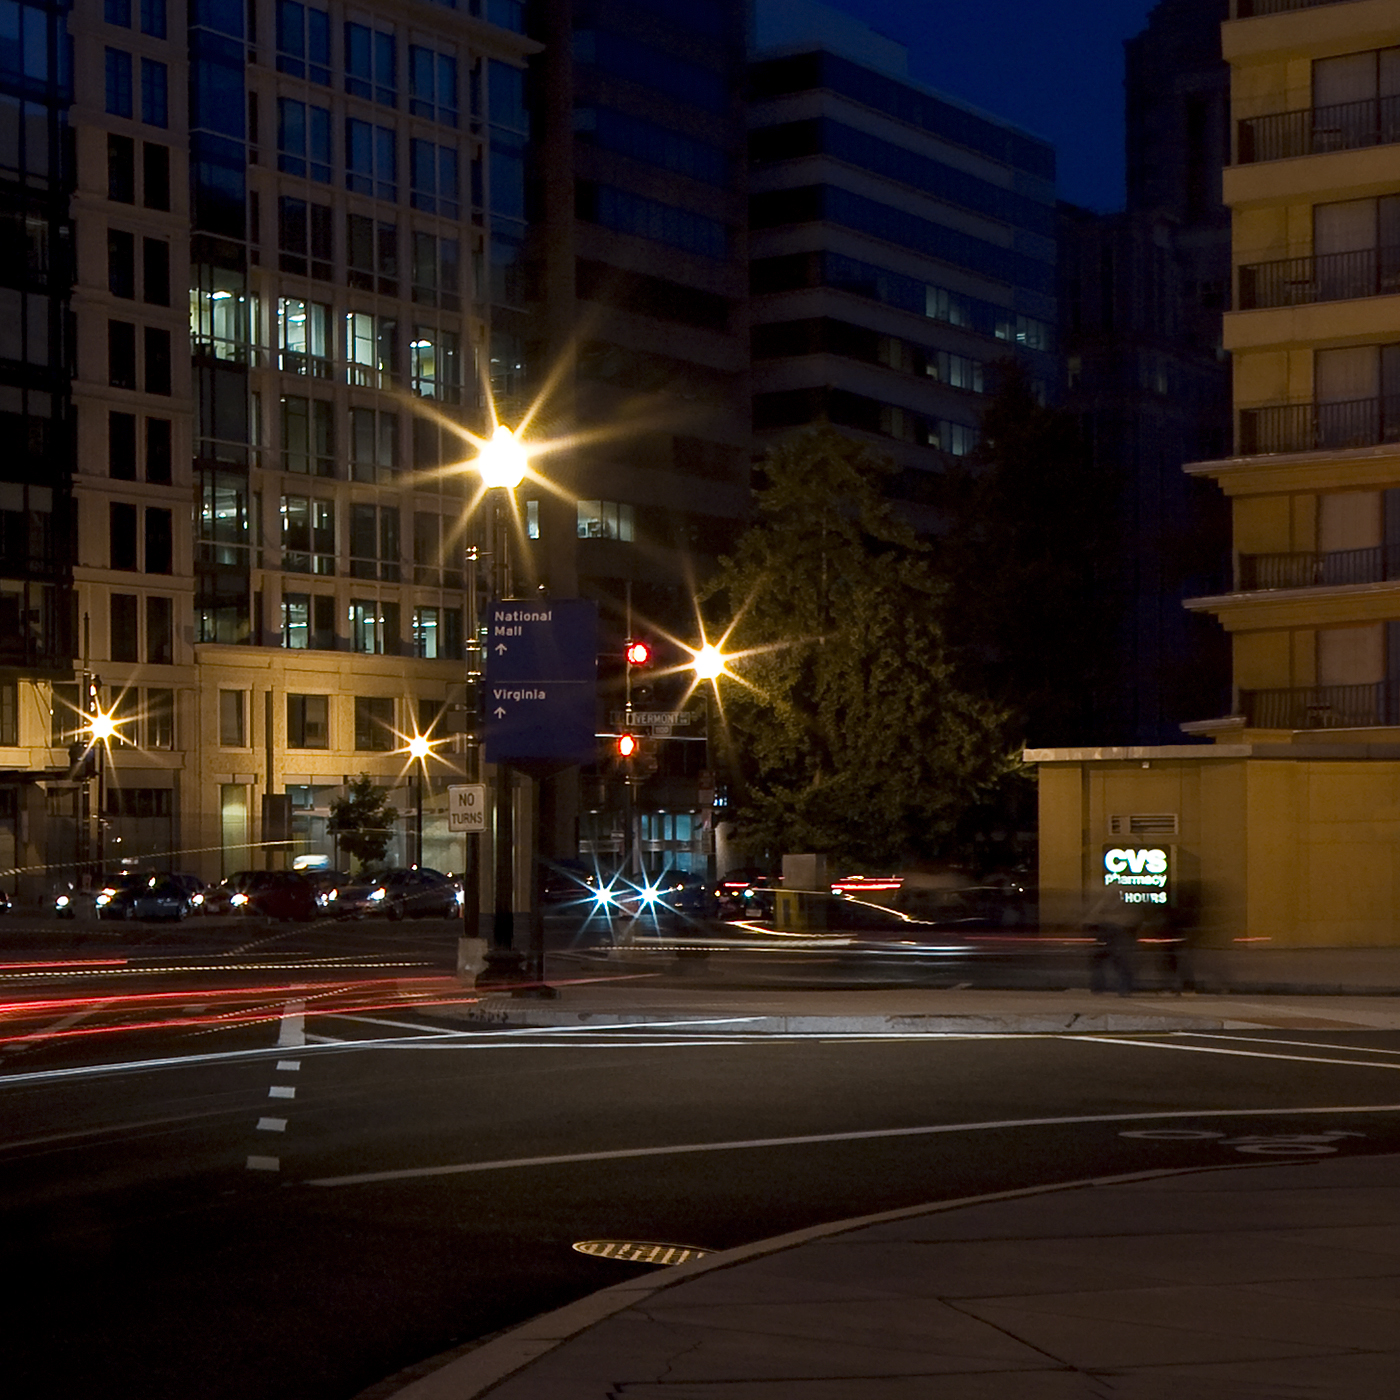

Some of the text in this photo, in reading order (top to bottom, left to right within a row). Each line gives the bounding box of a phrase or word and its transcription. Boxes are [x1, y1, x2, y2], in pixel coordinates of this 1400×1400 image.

[494, 610, 552, 621] National
[494, 625, 522, 636] Mall
[493, 689, 546, 701] Virginia
[636, 713, 678, 724] VERMONT
[458, 793, 475, 807] NO
[452, 811, 483, 824] TURNS
[1104, 848, 1168, 874] CVS
[1104, 873, 1167, 888] pharmacy
[1124, 891, 1168, 904] HOURS
